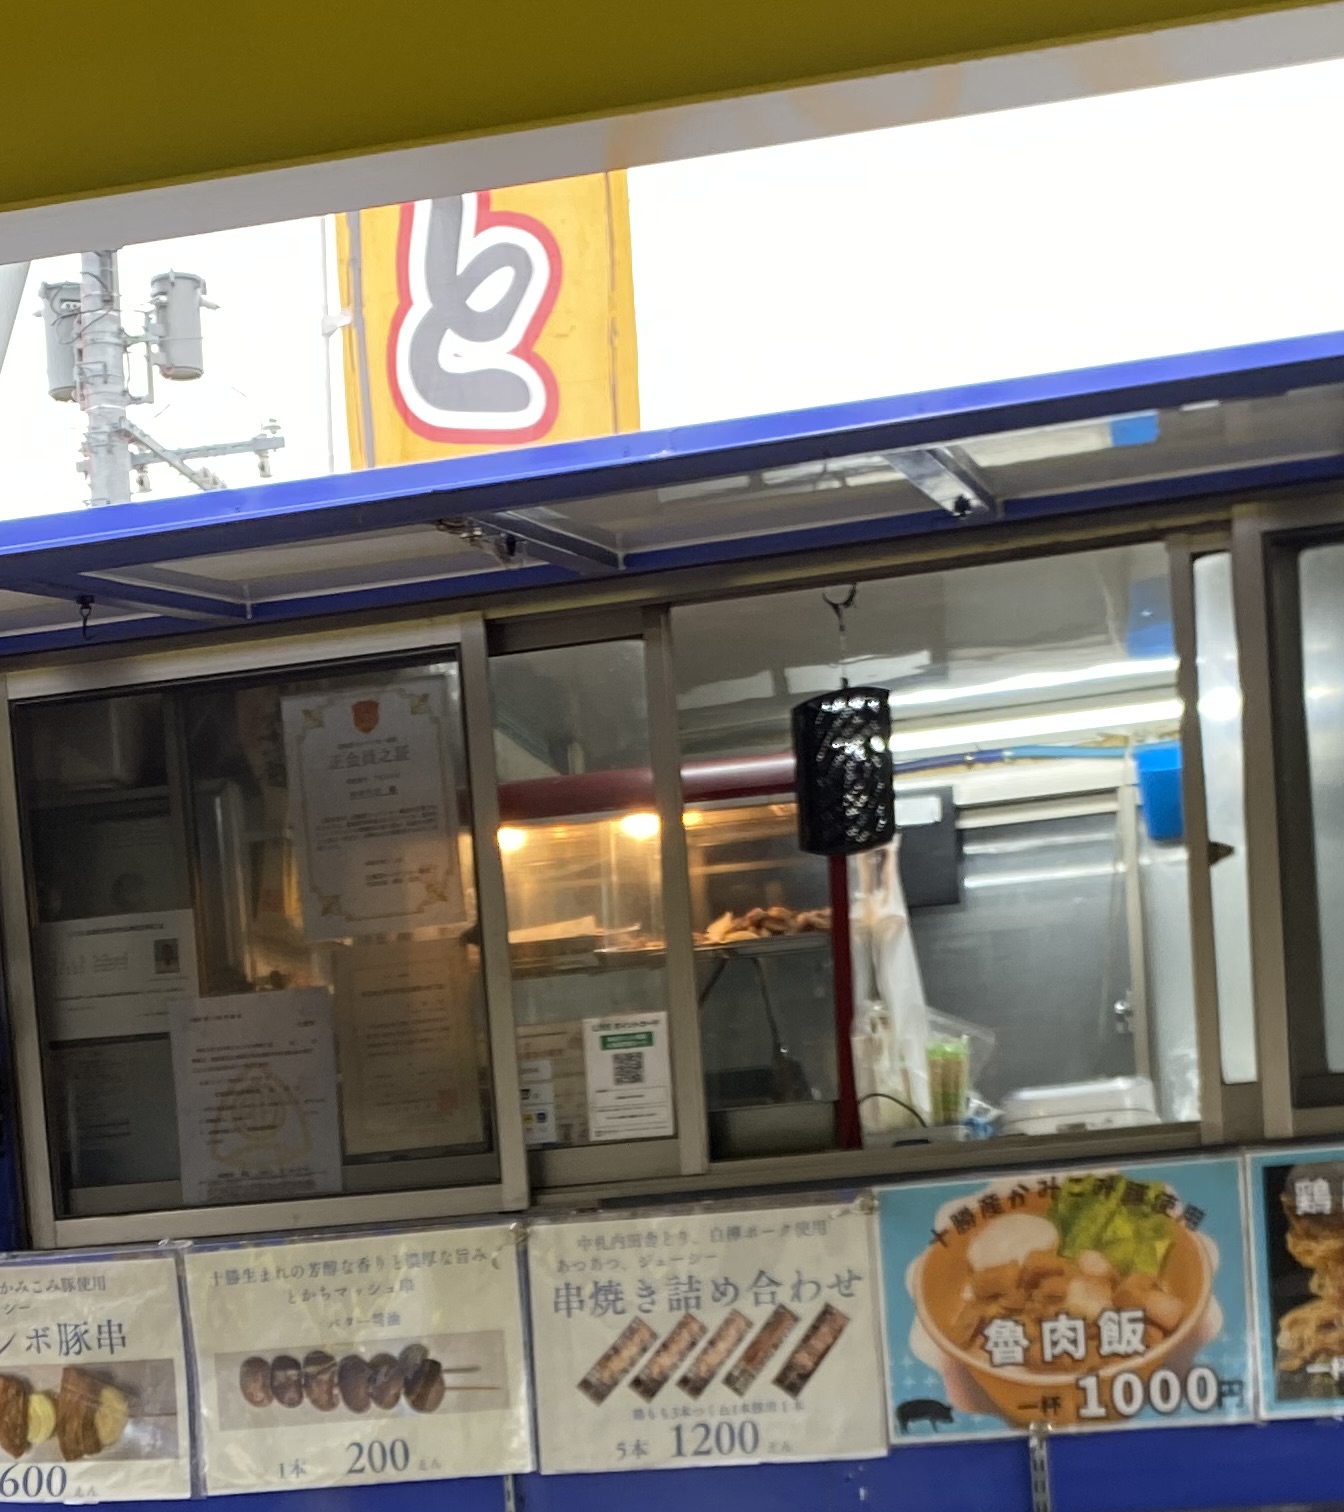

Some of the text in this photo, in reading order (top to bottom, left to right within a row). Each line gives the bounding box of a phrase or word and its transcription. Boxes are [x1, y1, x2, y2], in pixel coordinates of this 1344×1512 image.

[553, 1268, 863, 1318] 串焼き詰め合わせ
[983, 1309, 1147, 1367] 魯肉飯
[279, 1459, 305, 1479] 1本
[345, 1438, 410, 1475] 200
[615, 1441, 649, 1460] 5本
[670, 1420, 761, 1458] 1200
